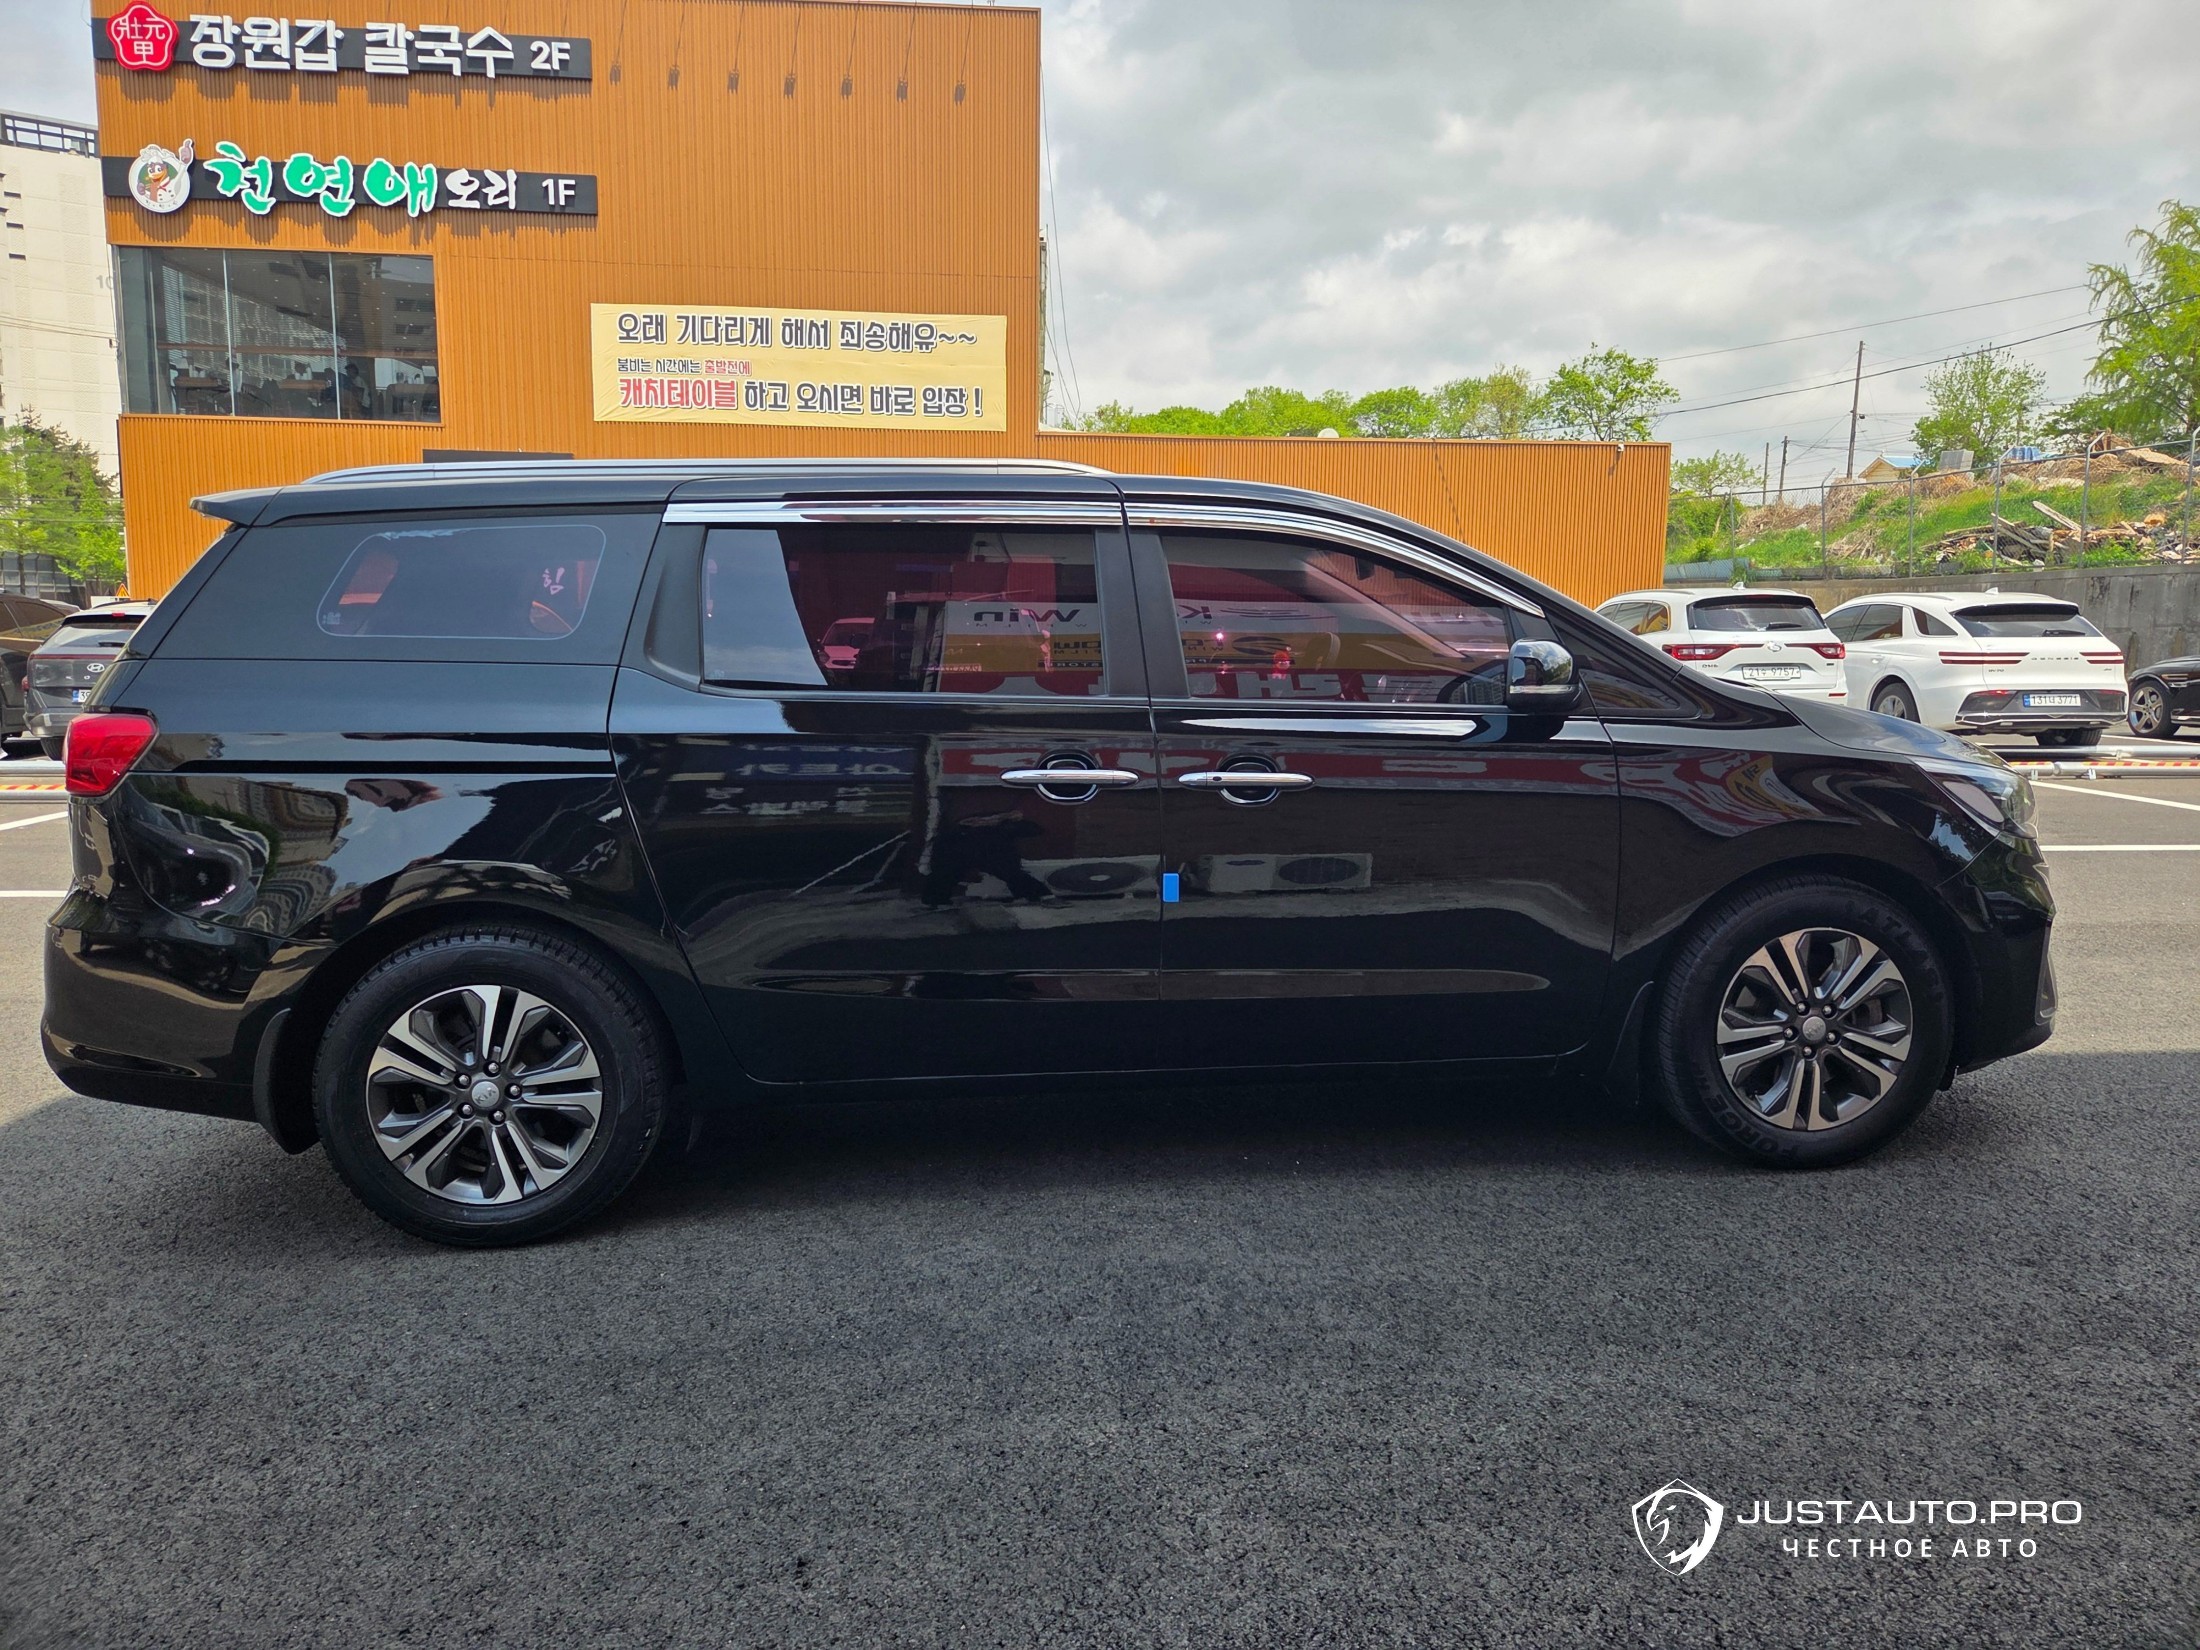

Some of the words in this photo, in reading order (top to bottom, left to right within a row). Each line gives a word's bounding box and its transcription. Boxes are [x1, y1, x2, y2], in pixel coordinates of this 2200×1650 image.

[190, 15, 345, 72] 장원갑
[365, 21, 514, 79] 칼국수
[530, 41, 570, 71] 2F
[445, 168, 517, 210] 오리
[541, 178, 576, 206] 1F
[617, 313, 666, 345] 오래
[676, 315, 772, 348] 기다리게
[781, 318, 831, 349] 해서
[617, 358, 652, 374] 붐비는
[655, 359, 702, 374] 시간에는
[704, 359, 751, 376] 출발전에
[619, 378, 738, 410] 캐치테이블
[744, 381, 789, 411] 하고
[796, 382, 863, 415] 오시면
[870, 385, 916, 415] 바로
[922, 386, 968, 416] 입장
[1771, 667, 1795, 676] 9757
[2057, 695, 2077, 705] 3771
